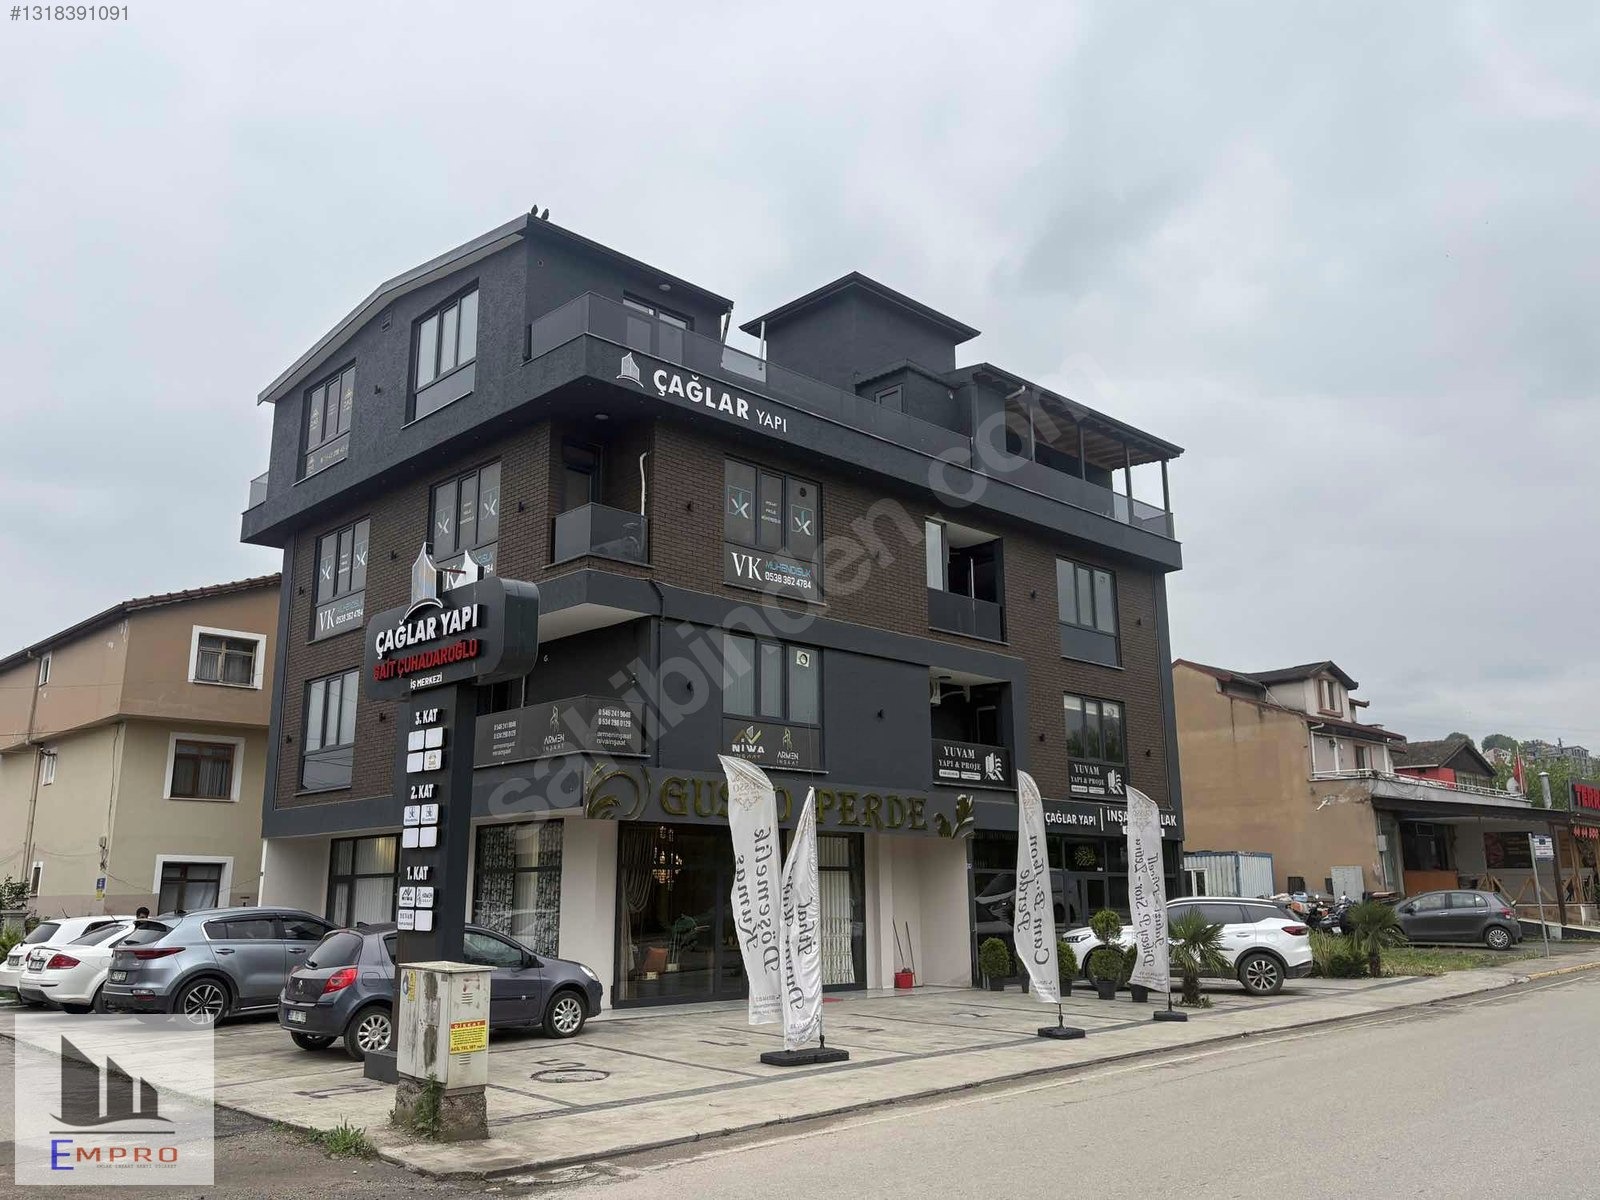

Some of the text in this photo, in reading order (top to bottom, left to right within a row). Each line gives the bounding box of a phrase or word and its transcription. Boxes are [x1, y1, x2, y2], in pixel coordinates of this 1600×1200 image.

[653, 369, 787, 433] ÇAĞLAR YAPI
[731, 552, 762, 580] VK
[320, 608, 335, 632] VK
[375, 604, 478, 660] ÇAĞLAR YAPI
[416, 672, 442, 688] MERKEZİ
[415, 708, 438, 725] 3. KAT
[777, 751, 799, 764] ARMEN
[943, 746, 975, 759] YUVAM
[961, 762, 981, 770] PROJE
[1074, 763, 1099, 775] YUVAM
[410, 783, 434, 800] 2. KAT
[816, 788, 928, 831] PERDE
[1045, 810, 1096, 826] ÇAĞLAR YAPI
[406, 866, 429, 881] 1. KAT
